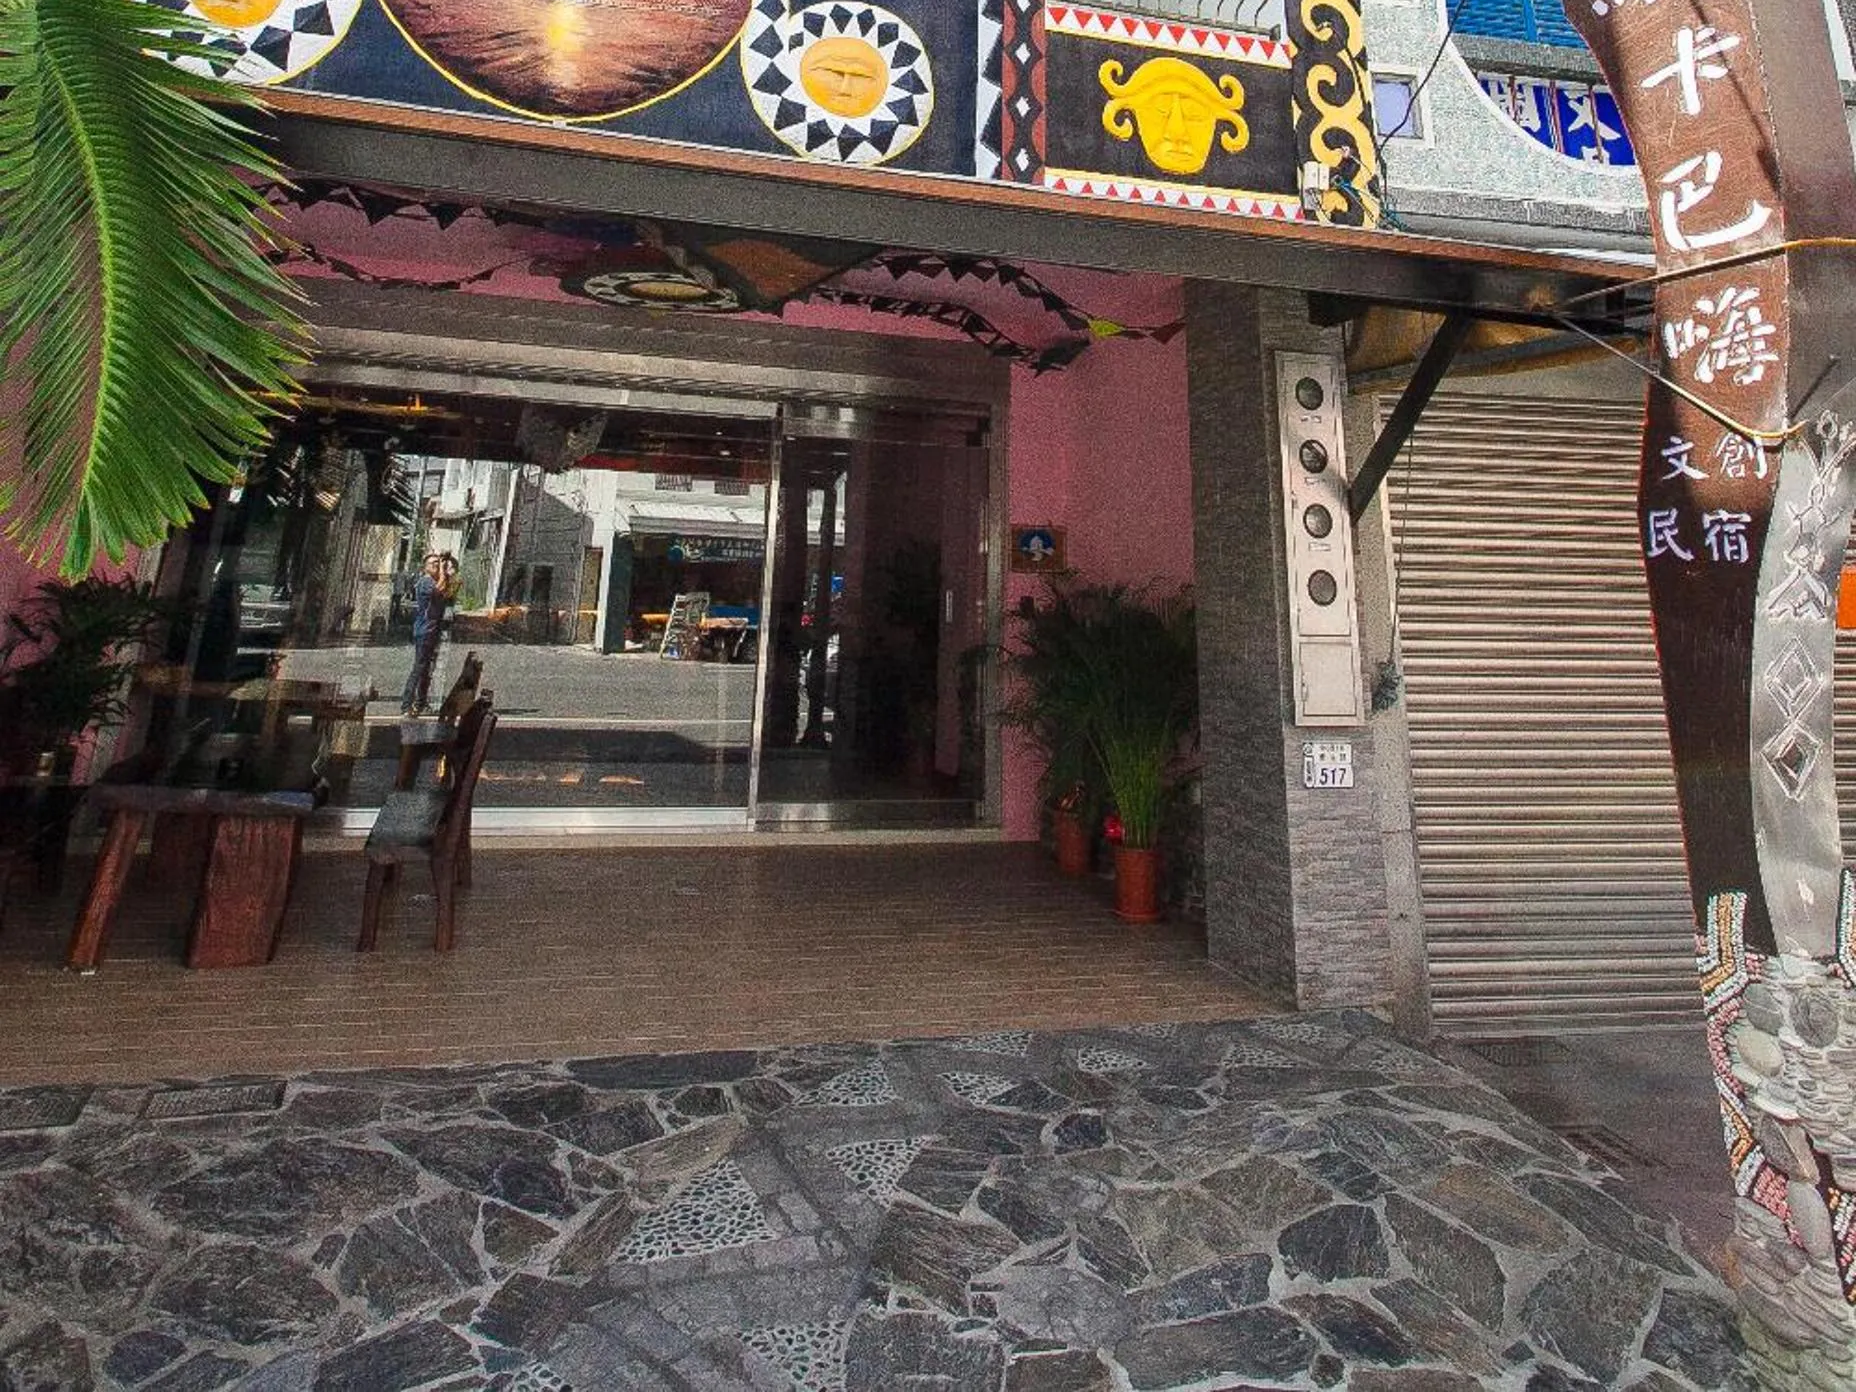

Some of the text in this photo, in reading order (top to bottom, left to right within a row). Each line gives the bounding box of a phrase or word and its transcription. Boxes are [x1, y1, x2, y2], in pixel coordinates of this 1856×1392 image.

[1661, 431, 1769, 481] 文創
[1646, 507, 1752, 563] 民宿
[1320, 768, 1346, 785] 517
